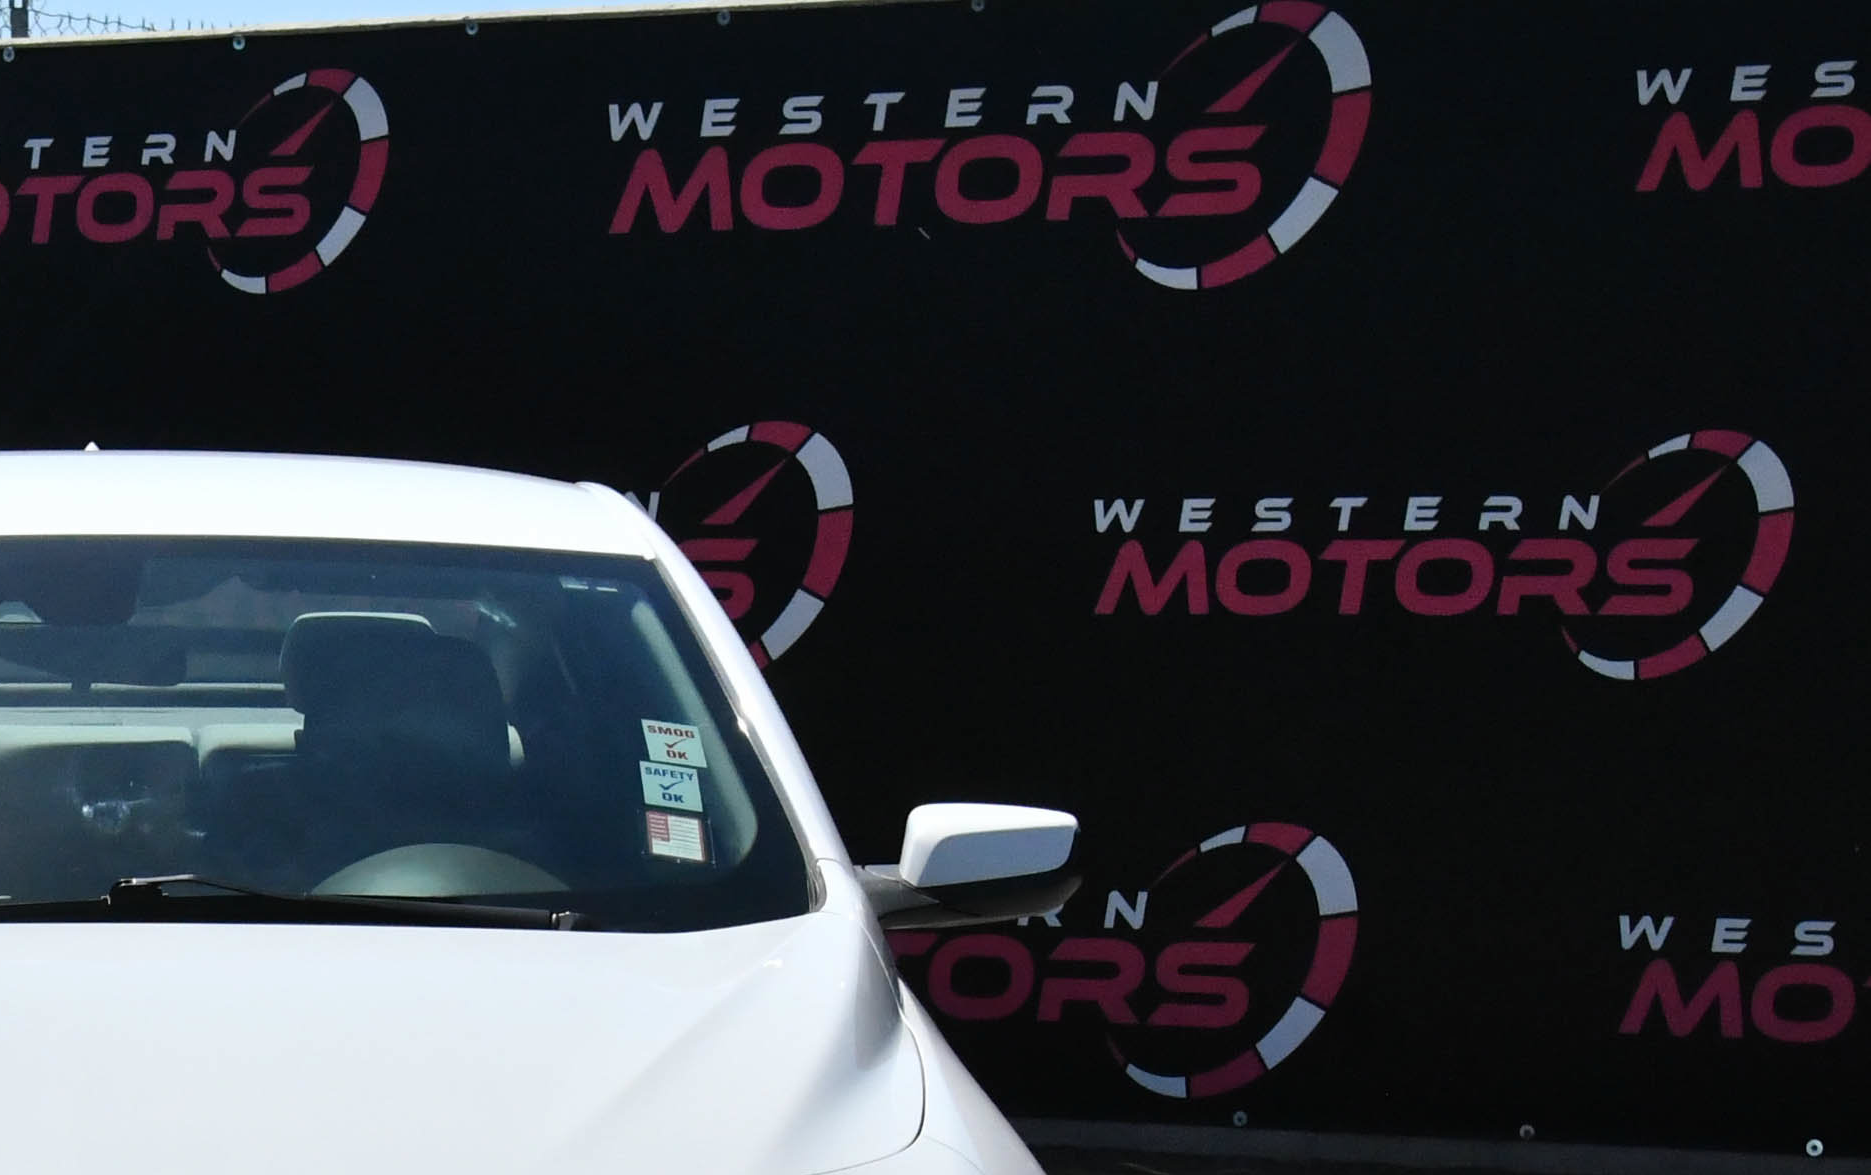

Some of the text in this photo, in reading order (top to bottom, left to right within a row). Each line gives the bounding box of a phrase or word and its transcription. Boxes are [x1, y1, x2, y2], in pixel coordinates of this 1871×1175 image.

[1636, 60, 1857, 106] WES
[608, 80, 1160, 142] WESTERN
[608, 124, 1267, 234] MOTORS
[1093, 494, 1600, 533] WESTERN
[1094, 538, 1699, 617] MOTORS
[646, 725, 696, 739] SMOG
[645, 766, 695, 781] SAFETY
[666, 750, 689, 760] OK
[662, 792, 685, 803] OK
[1619, 915, 1837, 956] WES
[1618, 958, 1871, 1043] MO
